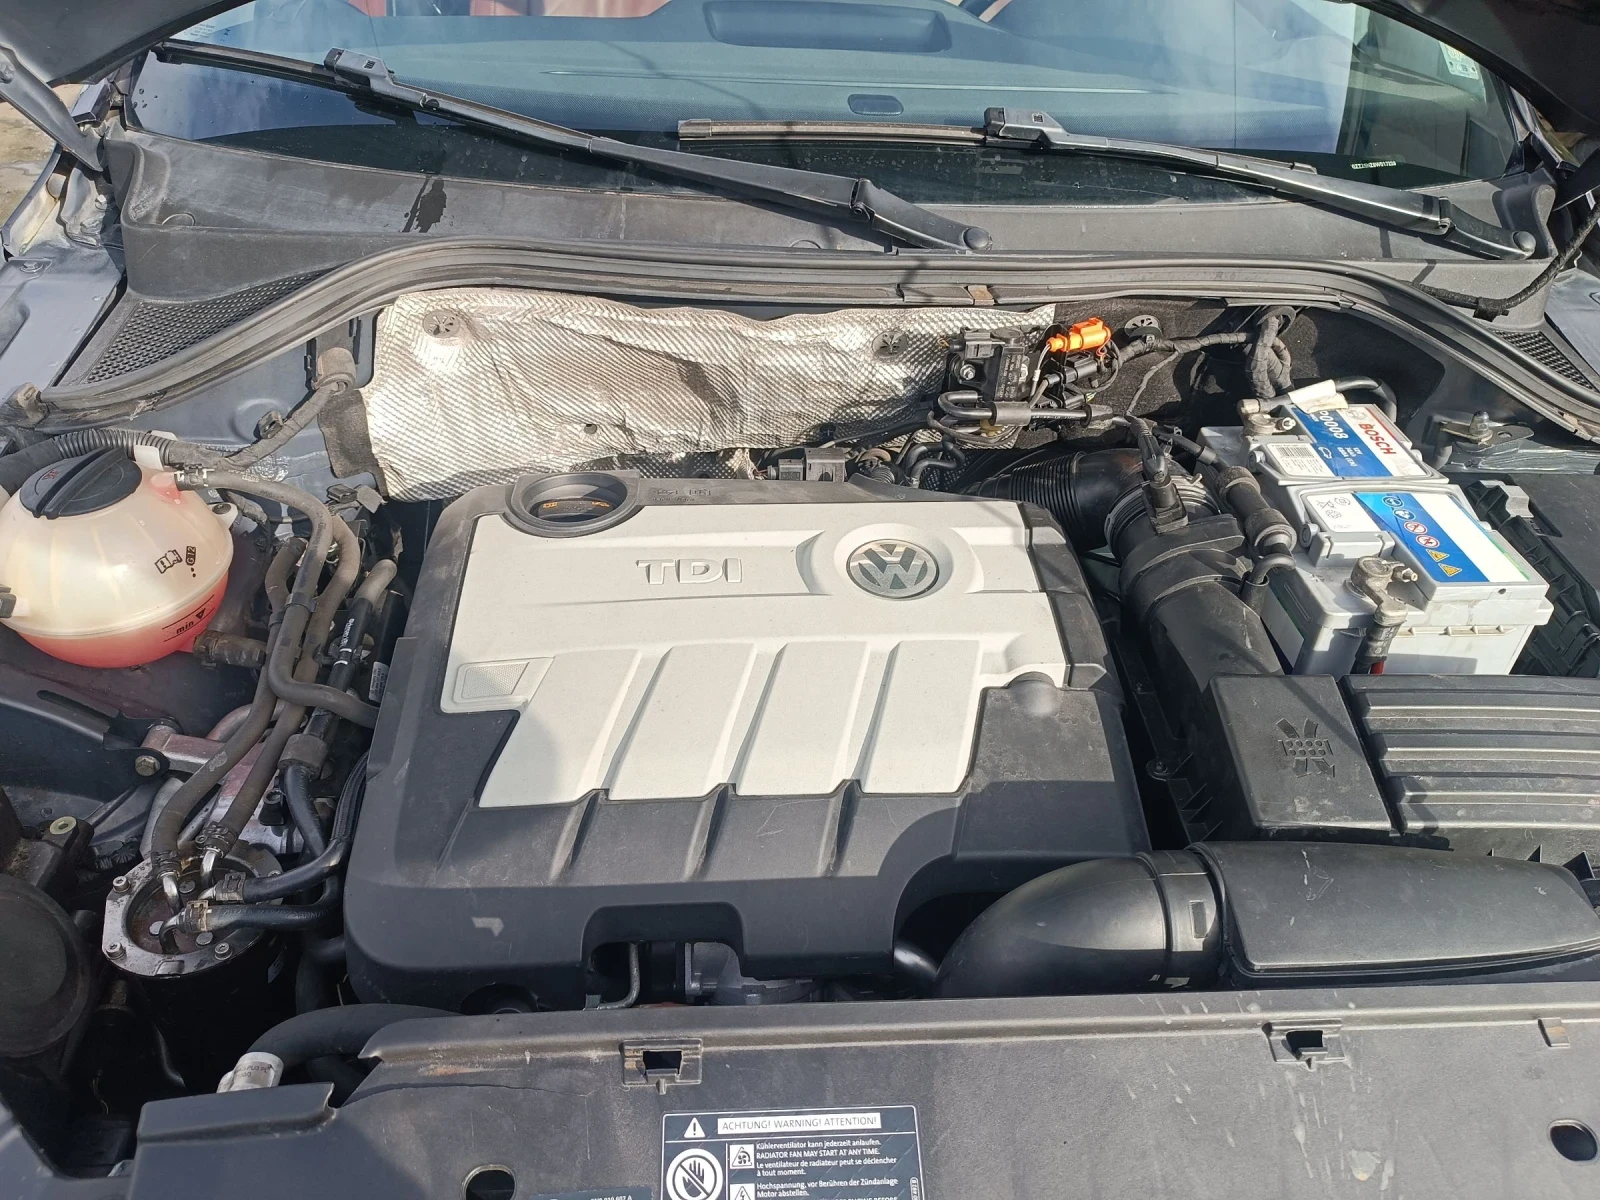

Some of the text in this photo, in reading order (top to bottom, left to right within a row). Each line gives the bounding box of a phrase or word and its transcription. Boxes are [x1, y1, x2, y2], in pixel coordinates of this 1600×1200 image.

[1358, 423, 1397, 455] BOSCH
[187, 546, 196, 565] G12
[636, 557, 743, 585] TDI
[176, 621, 194, 634] min
[722, 1115, 877, 1131] ACHTUNG! WARNING! ATTENTION!
[807, 1140, 823, 1148] kann
[823, 1139, 851, 1149] jederzeit
[852, 1138, 881, 1146] anlaufen.
[756, 1151, 788, 1159] RADIATOR
[803, 1150, 818, 1158] MAY
[819, 1149, 838, 1157] START
[848, 1148, 861, 1156] ANY
[862, 1147, 880, 1155] TIME.
[756, 1161, 764, 1169] Le
[764, 1160, 800, 1169] ventilateur
[809, 1159, 838, 1167] radiateur
[839, 1158, 855, 1168] peut
[762, 1169, 776, 1177] tout
[777, 1168, 807, 1176] moment.
[807, 1180, 818, 1188] vor
[848, 1178, 860, 1186] der
[756, 1188, 810, 1198] Motor abstellen.
